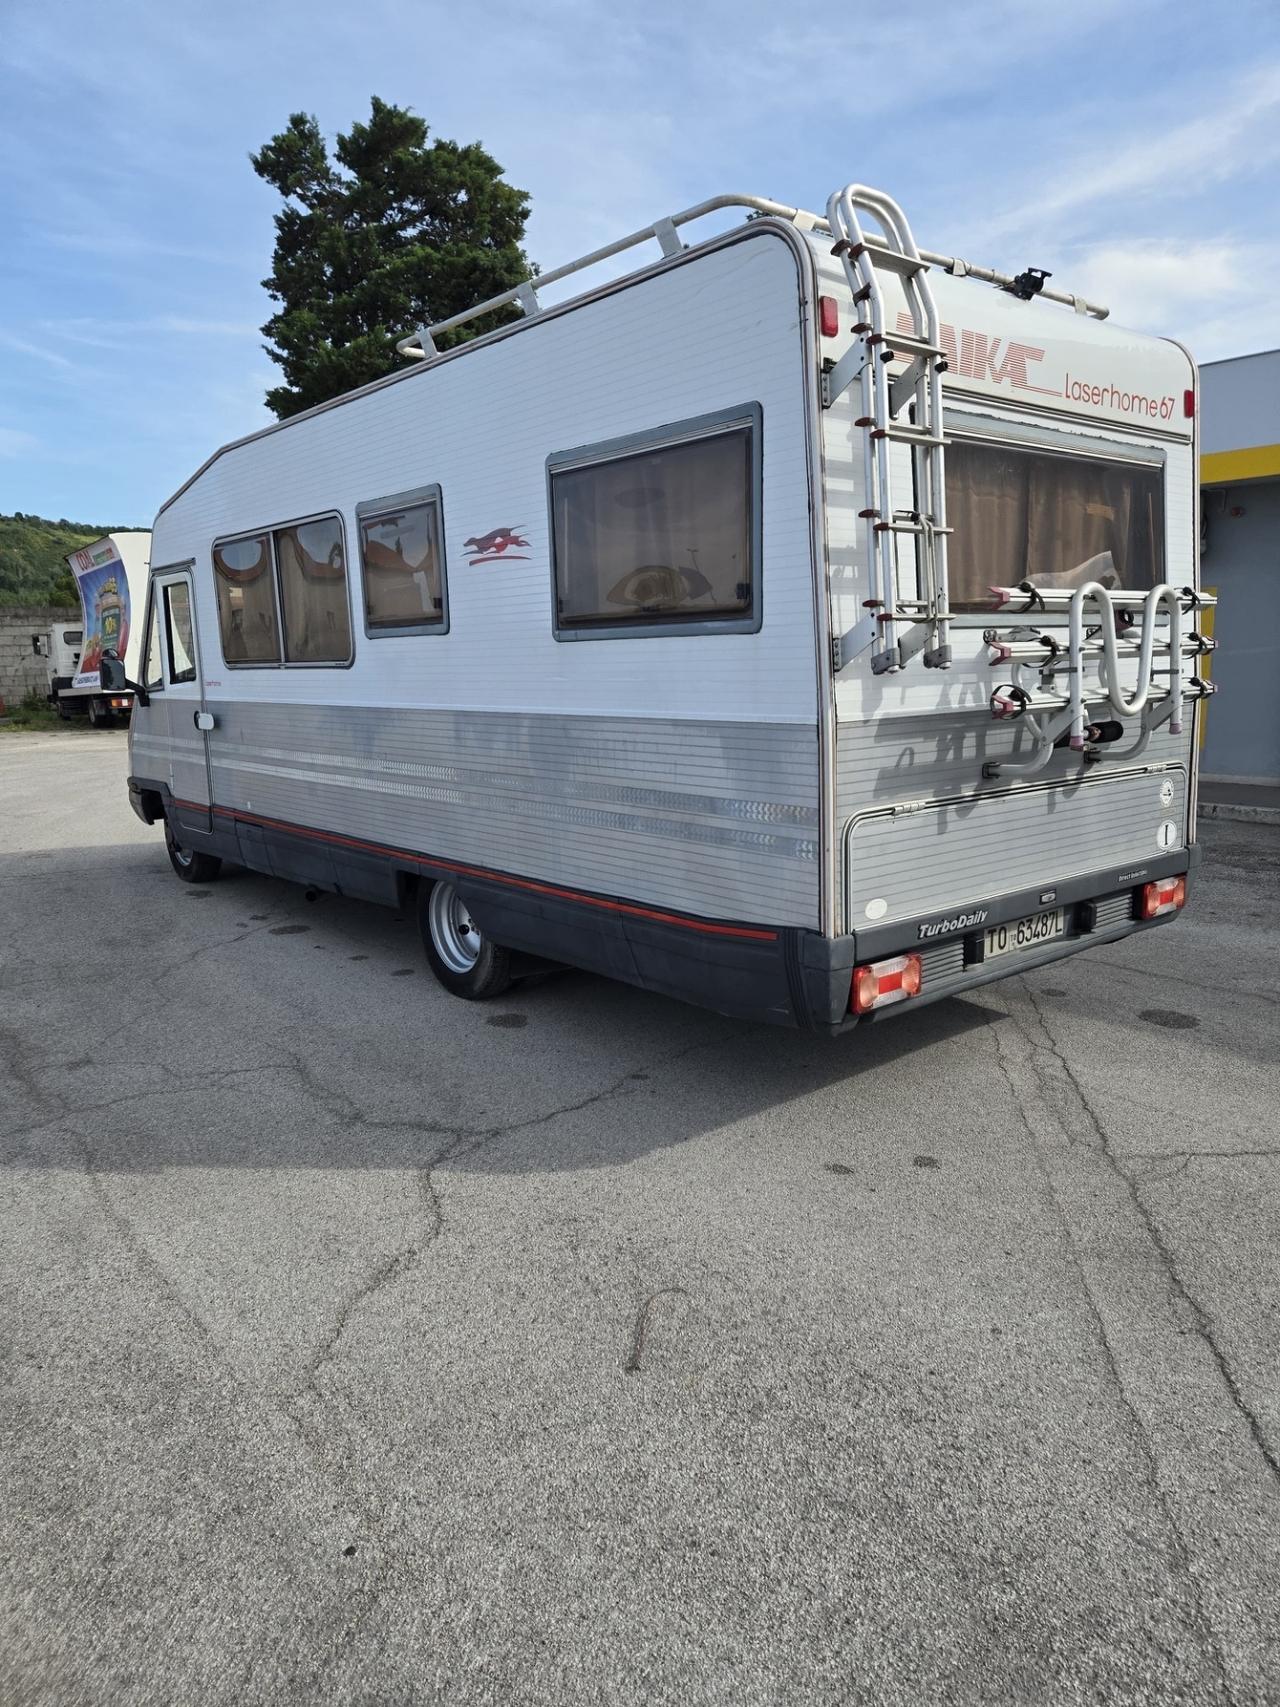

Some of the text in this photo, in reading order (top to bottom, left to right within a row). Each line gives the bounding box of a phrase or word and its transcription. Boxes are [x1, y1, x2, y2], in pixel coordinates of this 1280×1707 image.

[919, 910, 988, 939] TurboDaily
[987, 911, 1062, 953] TO 63487L
